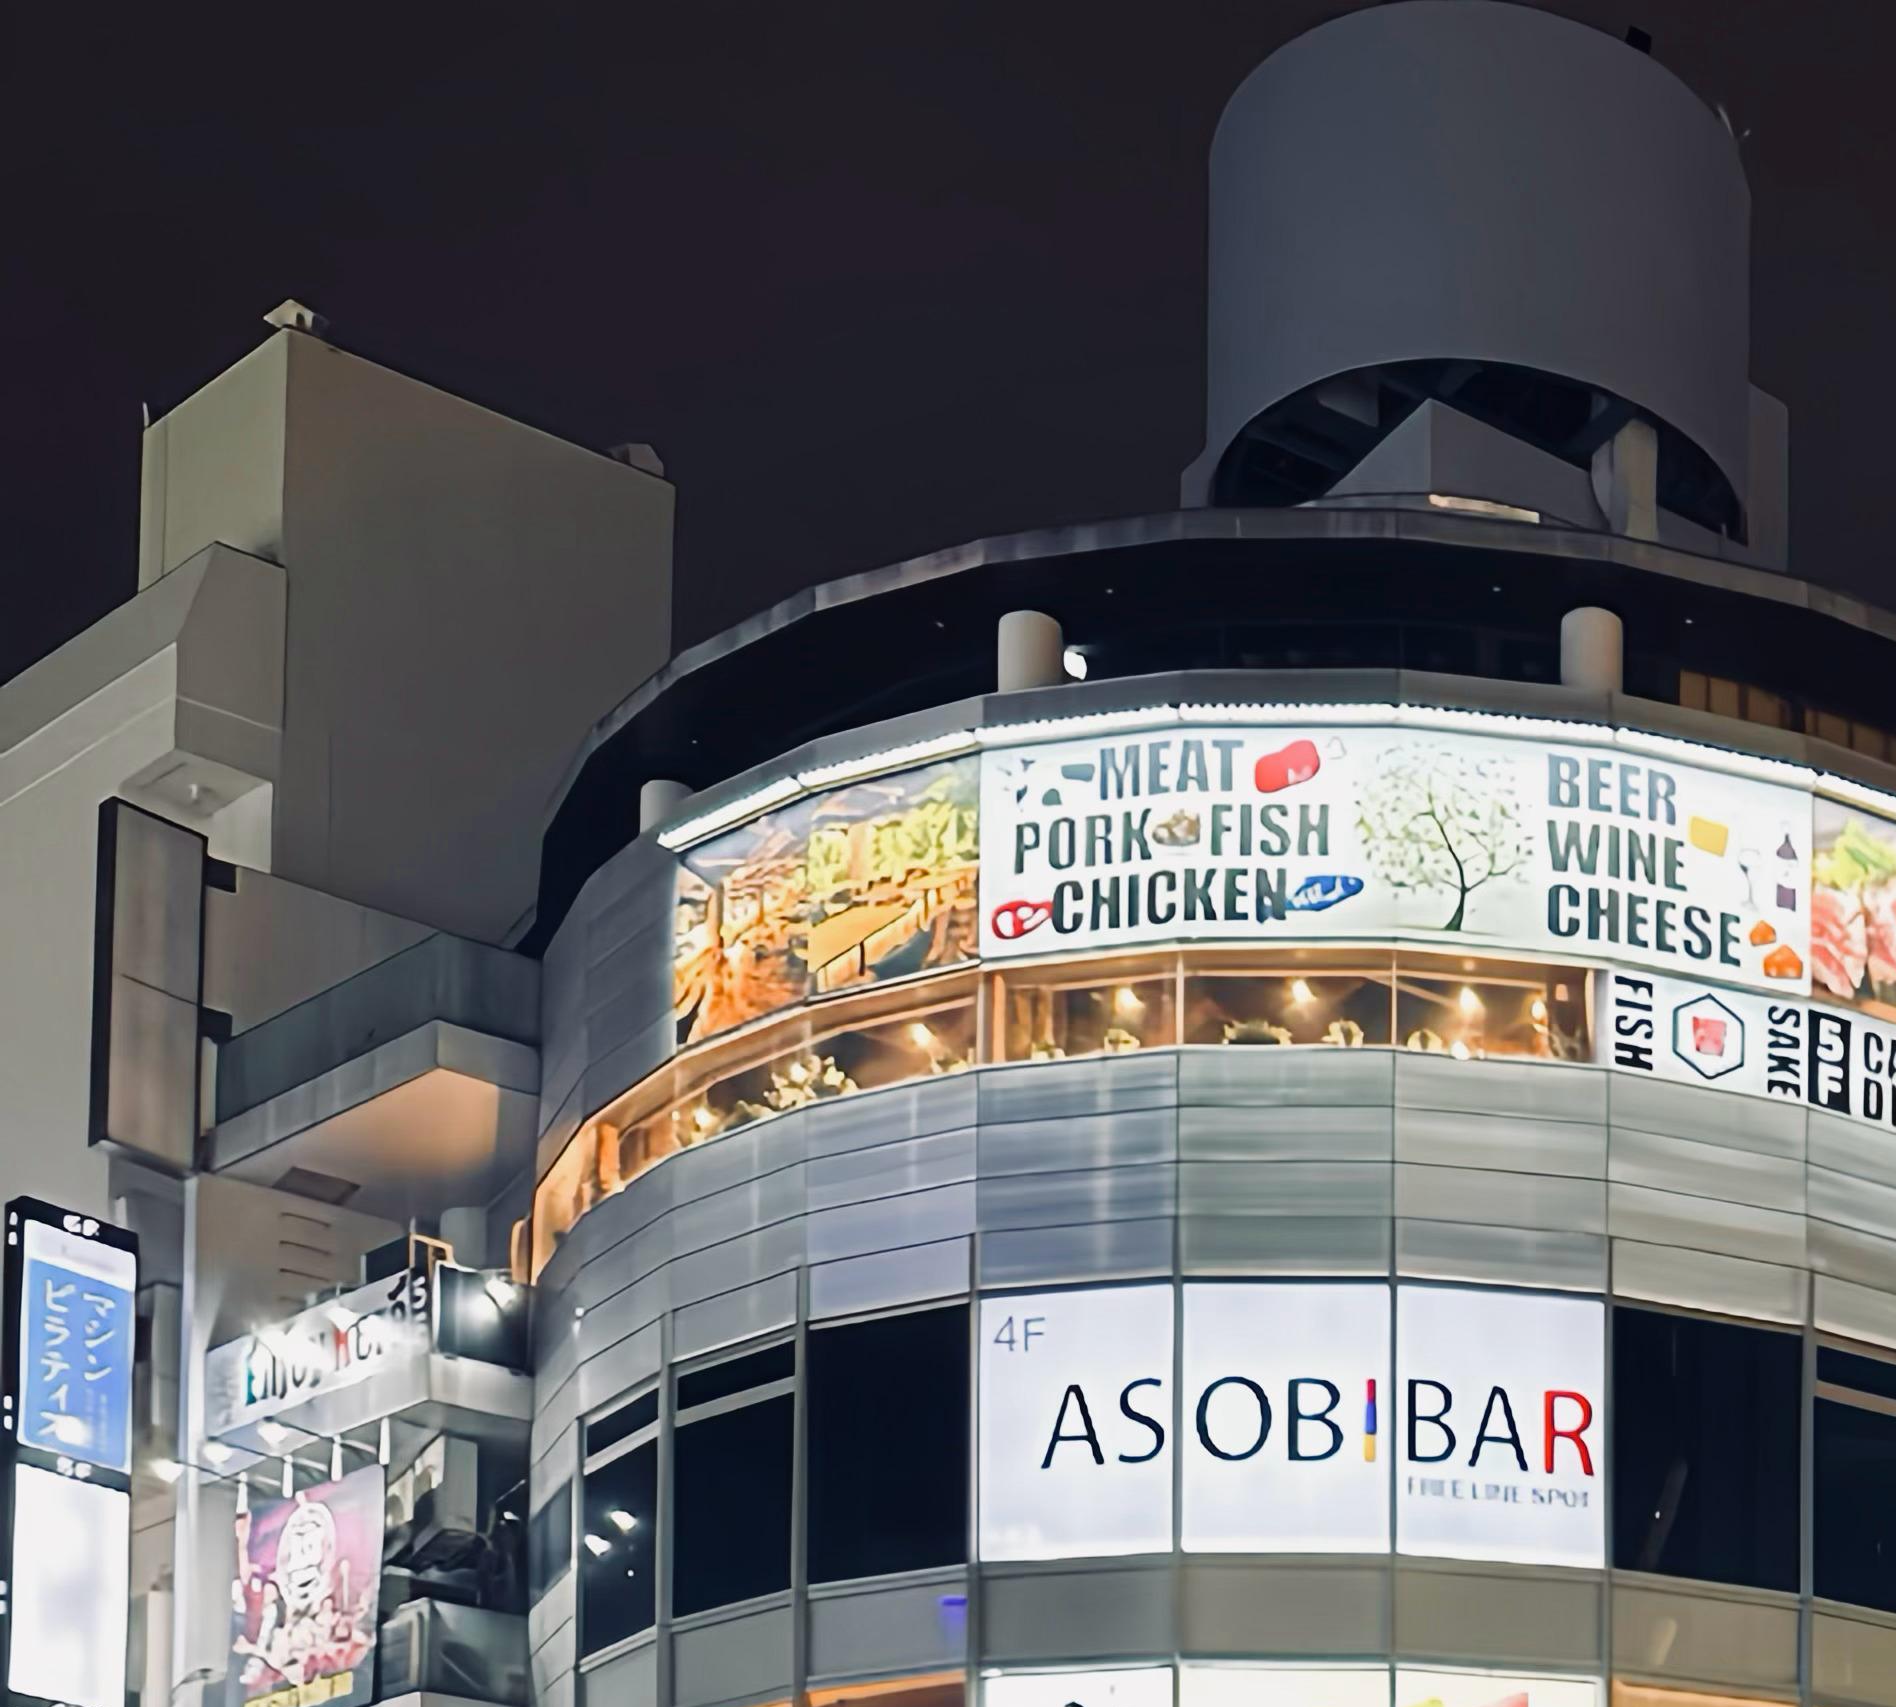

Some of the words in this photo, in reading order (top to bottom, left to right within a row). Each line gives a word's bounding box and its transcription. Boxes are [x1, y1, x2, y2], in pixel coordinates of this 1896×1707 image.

[1099, 740, 1244, 800] MEAT
[1548, 753, 1677, 826] BEER
[1014, 808, 1152, 875] PORK
[1211, 803, 1330, 857] FISH
[1546, 820, 1686, 893] WINE
[1051, 867, 1288, 935] CHICKEN
[1547, 883, 1742, 968] CHEESE
[1614, 975, 1653, 1072] FISH
[1767, 1005, 1801, 1099] SAKE
[993, 1315, 1047, 1352] 4F
